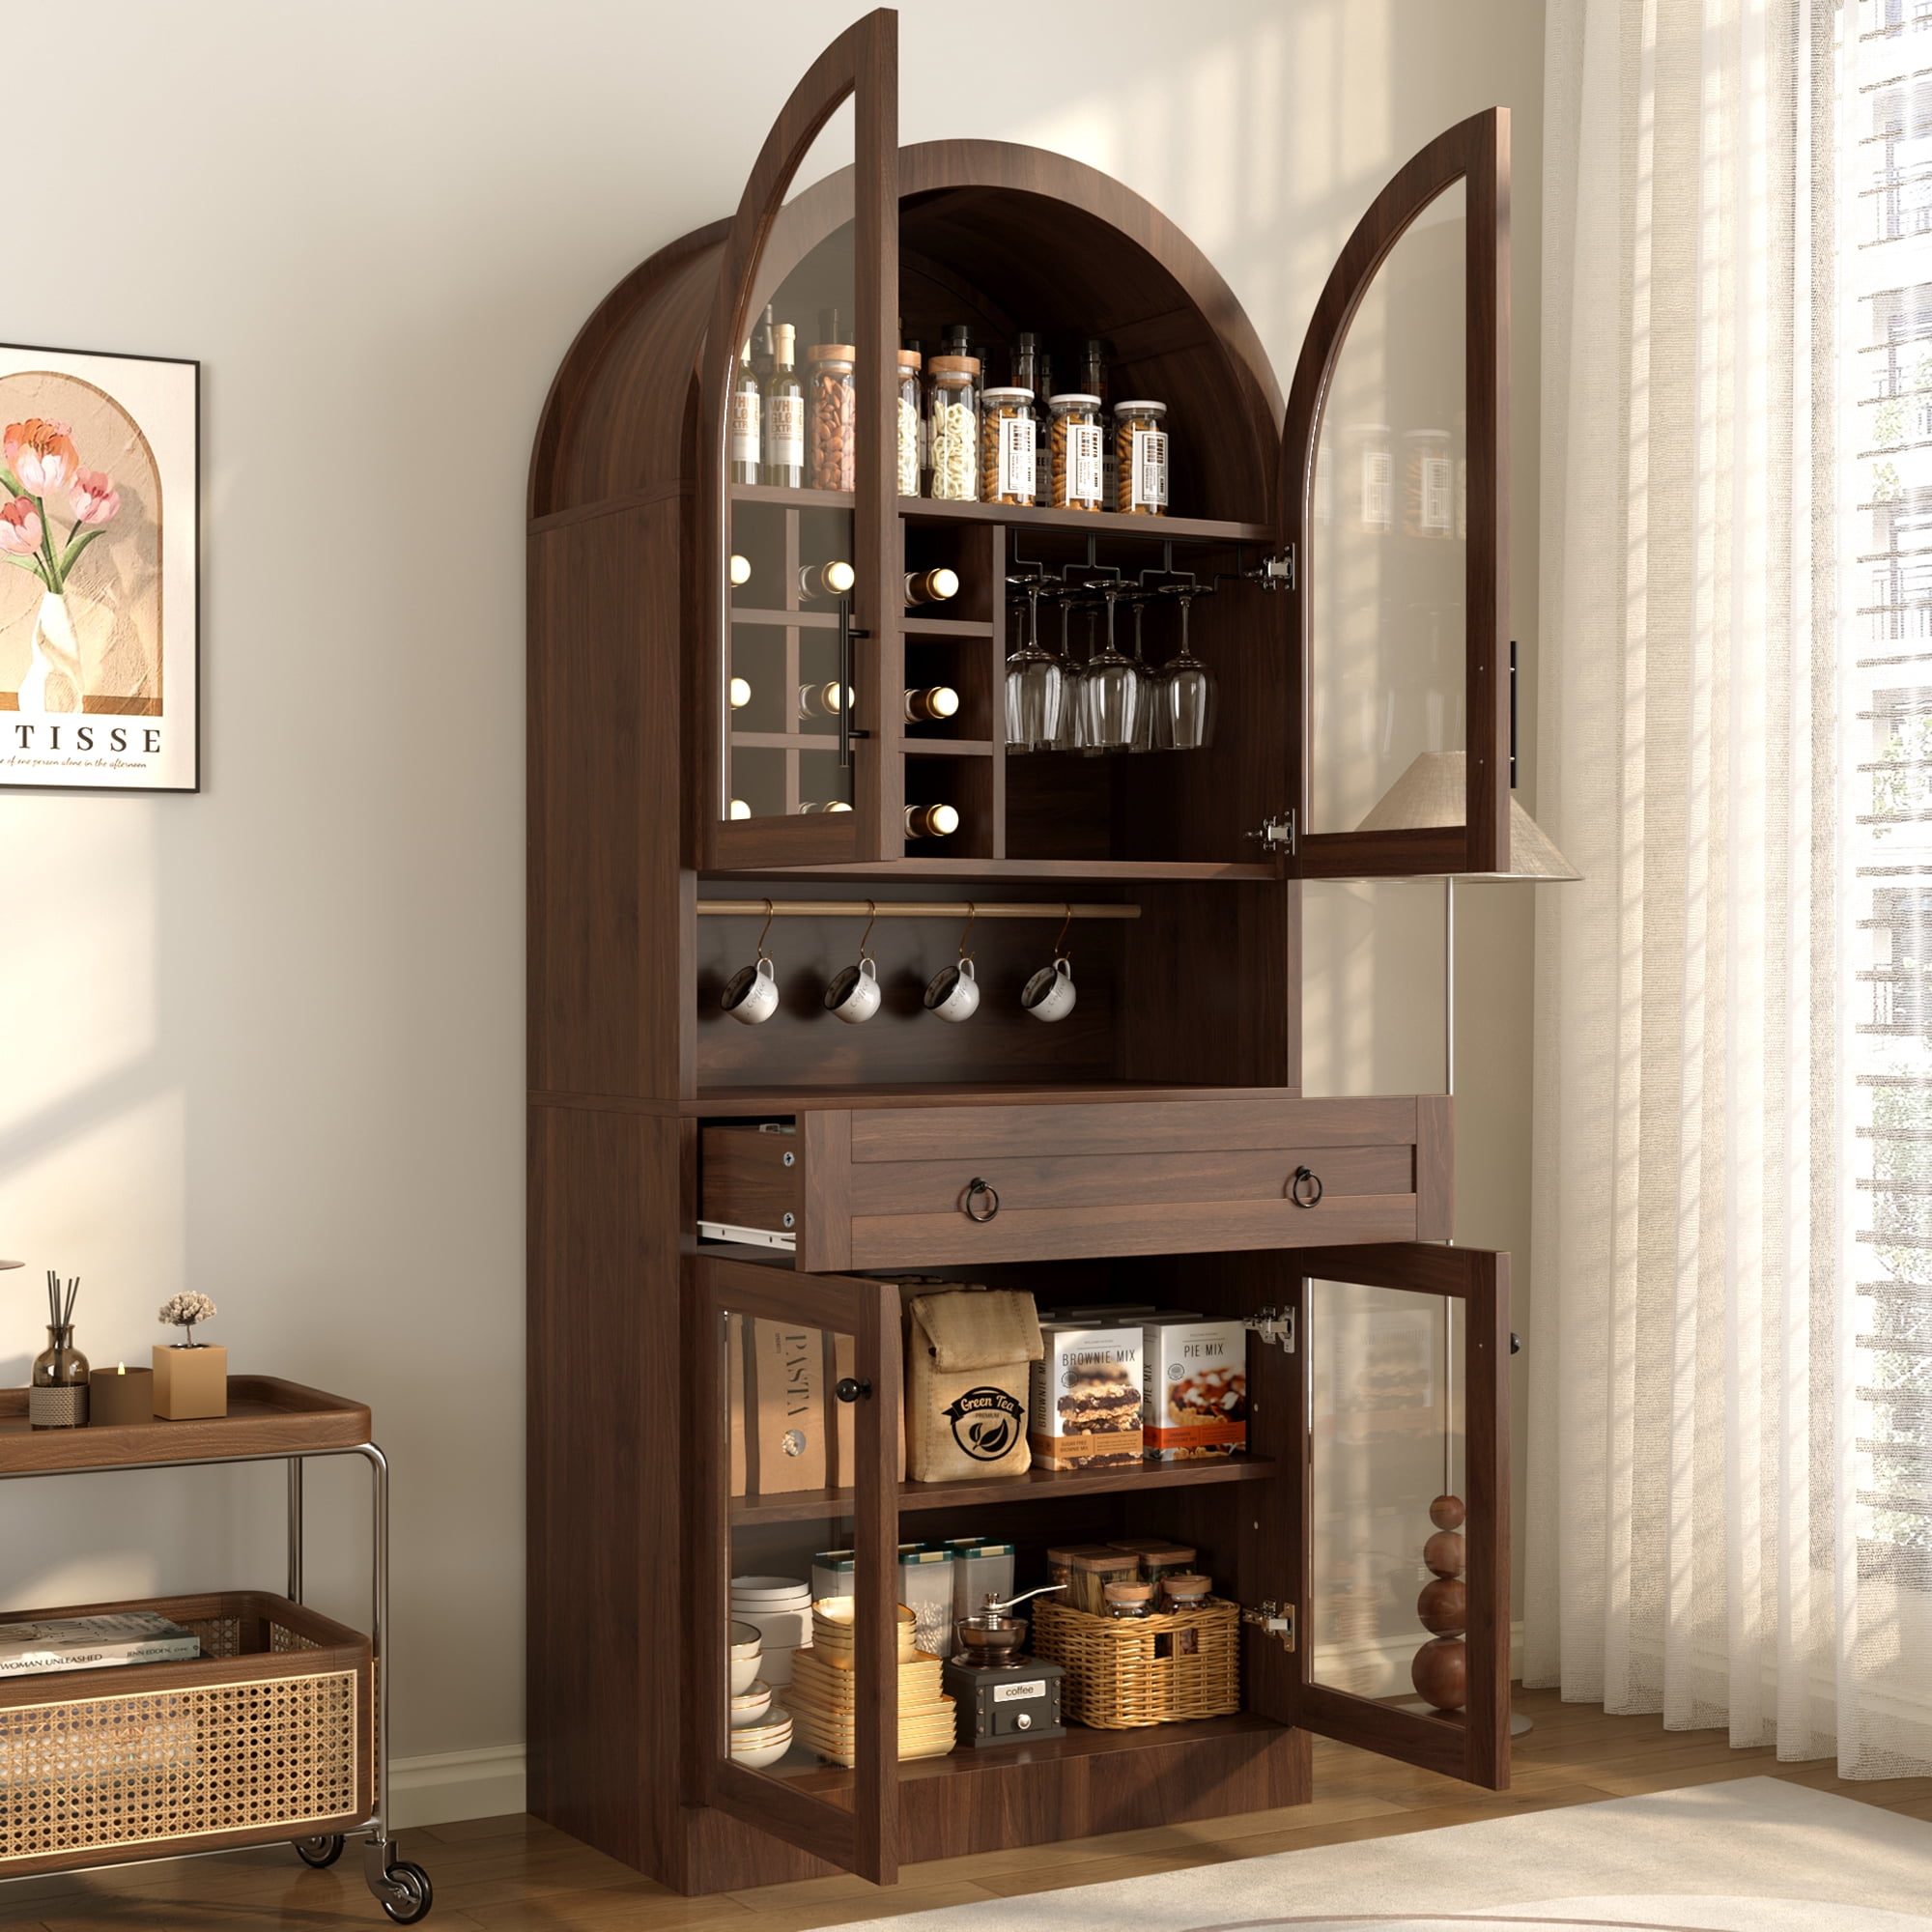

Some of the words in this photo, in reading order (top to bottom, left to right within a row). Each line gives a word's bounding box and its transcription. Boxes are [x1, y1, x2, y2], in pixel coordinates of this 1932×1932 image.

[7, 754, 16, 767] of
[61, 757, 82, 766] alone
[95, 757, 107, 767] the
[109, 758, 147, 770] afternoon
[1063, 1350, 1111, 1366] BROWNIE
[1117, 1350, 1135, 1362] MIX
[1184, 1345, 1201, 1357] PIE
[1206, 1343, 1224, 1356] MIX
[785, 1335, 810, 1416] PASTA
[1144, 1363, 1152, 1382] MIX
[960, 1397, 992, 1411] Green
[996, 1395, 1014, 1411] Tea
[1144, 1387, 1152, 1405] PIE
[1037, 1381, 1047, 1428] BROWNIE
[127, 1649, 144, 1658] JENN
[0, 1660, 43, 1670] WOMAN
[45, 1654, 102, 1666] UNLEASHED
[1006, 1686, 1035, 1697] coffee
